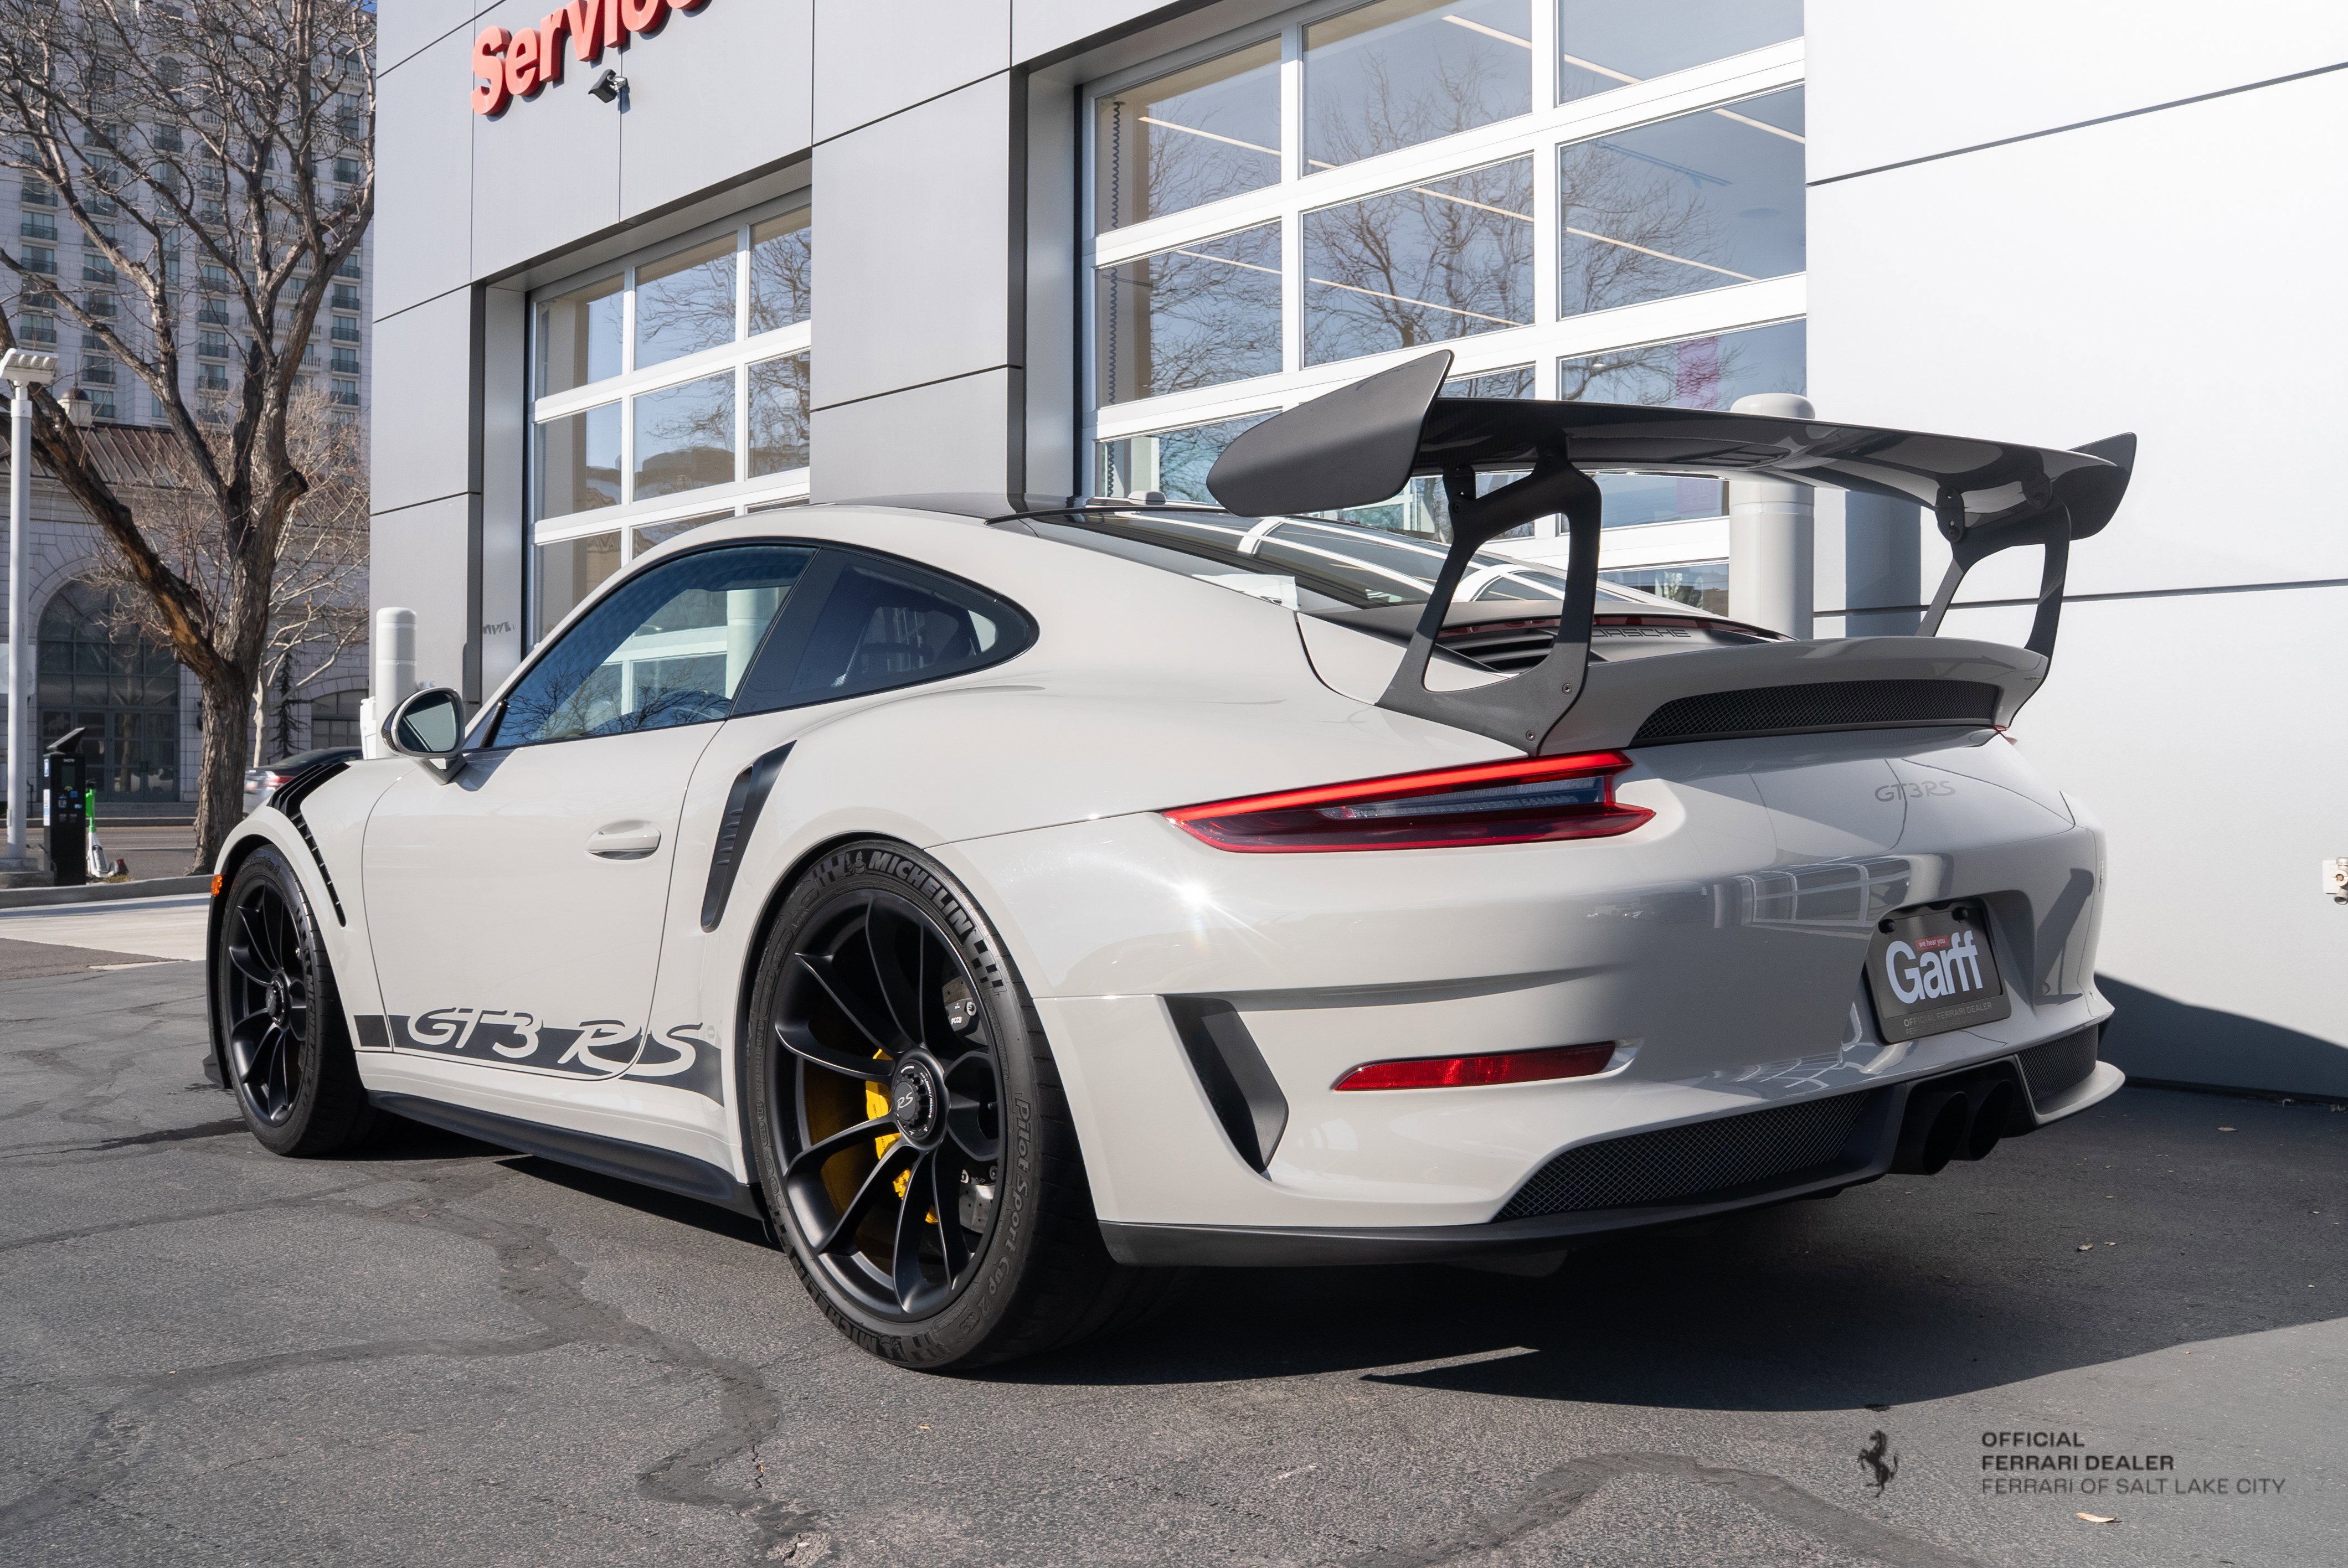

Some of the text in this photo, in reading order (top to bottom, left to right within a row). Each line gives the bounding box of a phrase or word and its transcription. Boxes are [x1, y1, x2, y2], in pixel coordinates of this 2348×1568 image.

[471, 0, 713, 116] Servi
[1592, 628, 1692, 637] ORSCHE
[868, 850, 974, 936] MICHELIN
[1886, 930, 1983, 1004] Garff
[1937, 938, 1946, 946] you
[1903, 1014, 1936, 1027] OFFICIAL
[1937, 1007, 1966, 1019] FERRARI
[1966, 1002, 1992, 1014] DEALER
[897, 1091, 914, 1111] RS
[1015, 1098, 1031, 1173] Pilot
[1005, 1174, 1028, 1252] Sport
[988, 1256, 1010, 1296] Cup
